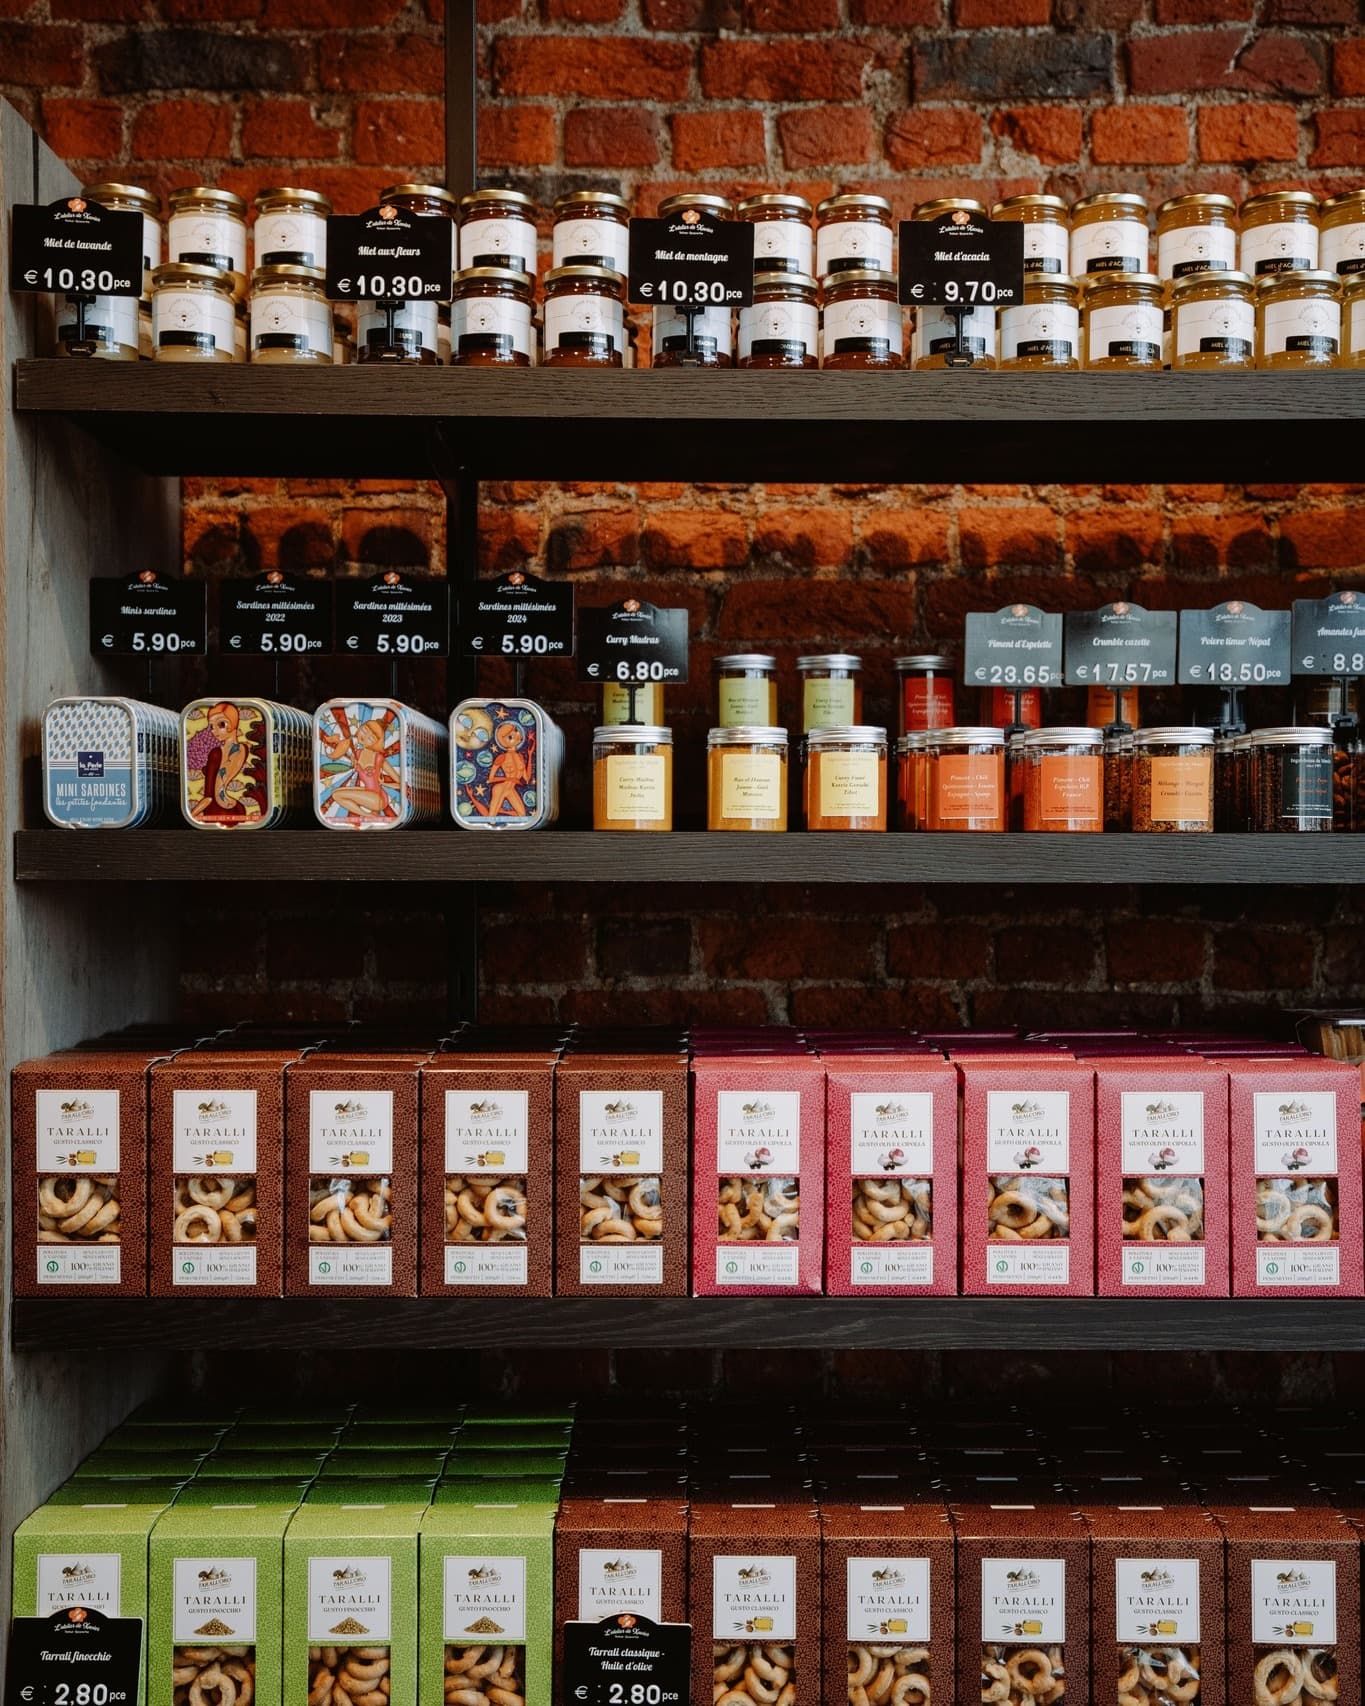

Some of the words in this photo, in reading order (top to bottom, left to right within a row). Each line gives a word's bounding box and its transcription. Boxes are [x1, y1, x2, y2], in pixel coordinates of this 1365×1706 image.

[44, 238, 62, 247] Miel
[64, 240, 75, 248] de
[77, 240, 111, 250] lavande
[359, 246, 376, 255] Miel
[393, 247, 420, 258] fleurs
[655, 250, 673, 259] Miel
[675, 252, 685, 260] de
[686, 253, 728, 264] montagne
[935, 252, 952, 260] Miel
[954, 252, 989, 261] d'acacia
[24, 270, 37, 284] €
[114, 280, 130, 289] pce
[338, 279, 350, 292] €
[425, 284, 440, 294] pce
[640, 283, 653, 296] €
[726, 291, 742, 300] pce
[911, 284, 924, 297] €
[997, 289, 1013, 299] pce
[121, 606, 142, 614] Minis
[237, 601, 270, 609] Sardines
[353, 601, 387, 610] Sardines
[388, 603, 432, 611] millésimées
[479, 602, 512, 610] Sardines
[513, 603, 556, 611] millésimées
[383, 614, 402, 622] 2023
[507, 615, 527, 623] 2024
[1317, 627, 1351, 636] Amandes
[102, 635, 113, 647] €
[230, 636, 241, 648] €
[308, 641, 321, 649] pce
[347, 636, 358, 648] €
[425, 642, 439, 650] pce
[472, 637, 483, 649] €
[549, 642, 563, 650] pce
[606, 635, 628, 646] Curry
[630, 635, 659, 644] Madras
[988, 640, 1013, 648] Piment
[1015, 640, 1052, 650] d'Espelette
[1093, 638, 1123, 646] Crumble
[1201, 637, 1224, 645] Poivre
[1248, 637, 1270, 647] Népal
[1303, 656, 1314, 668] €
[587, 664, 599, 676] €
[664, 669, 678, 677] pce
[975, 667, 986, 679] €
[1076, 666, 1087, 678] €
[1153, 670, 1167, 679] pce
[1190, 665, 1201, 677] €
[1267, 670, 1281, 679] pce
[57, 784, 77, 796] MINI
[81, 784, 125, 796] SARDINES
[47, 1128, 108, 1136] TARALLI
[184, 1128, 245, 1137] TARALLI
[320, 1128, 382, 1137] TARALLI
[456, 1128, 517, 1137] TARALLI
[591, 1128, 652, 1137] TARALLI
[728, 1128, 790, 1137] TARALLI
[862, 1130, 923, 1138] TARALLI
[998, 1128, 1059, 1137] TARALLI
[1132, 1129, 1193, 1138] TARALLI
[1264, 1129, 1325, 1138] TARALLI
[589, 1587, 651, 1596] TARALLI
[184, 1597, 245, 1605] TARALLI
[318, 1595, 380, 1603] TARALLI
[454, 1595, 515, 1603] TARALLI
[724, 1594, 786, 1603] TARALLI
[858, 1596, 920, 1605] TARALLI
[992, 1597, 1054, 1606] TARALLI
[1127, 1597, 1189, 1607] TARALLI
[1262, 1598, 1325, 1608] TARALLI
[40, 1651, 71, 1660] Tarrali
[70, 1651, 112, 1663] finocchio
[589, 1647, 619, 1656] Tarrali
[621, 1649, 660, 1659] classique
[601, 1661, 623, 1670] Huile
[625, 1662, 652, 1671] d'olive
[21, 1686, 34, 1700] €
[110, 1692, 126, 1702] pce
[575, 1686, 588, 1699] €
[662, 1693, 678, 1702] pce
